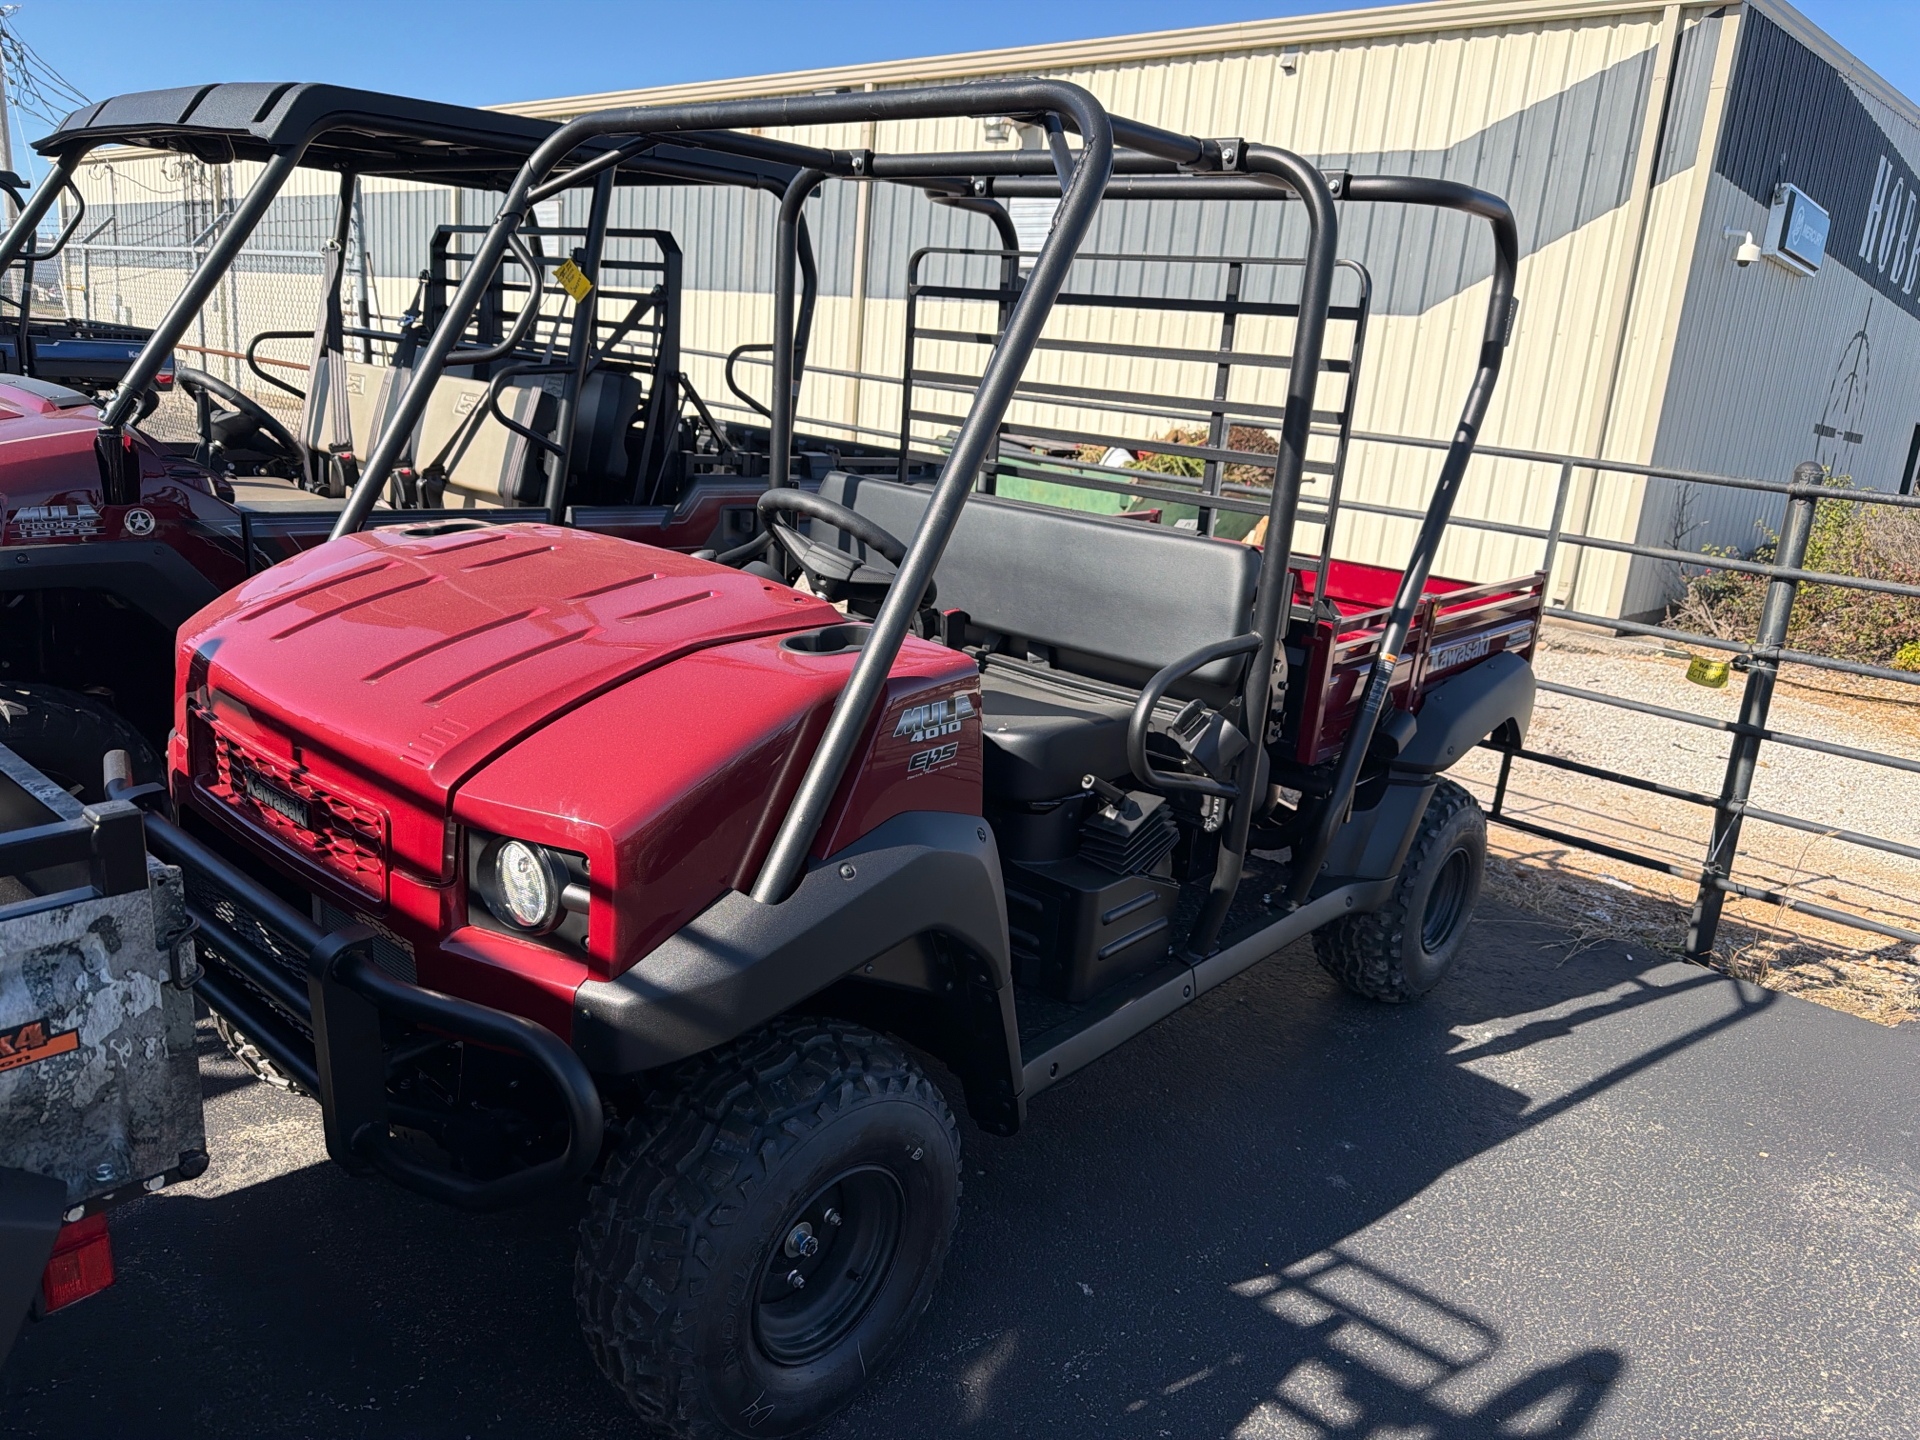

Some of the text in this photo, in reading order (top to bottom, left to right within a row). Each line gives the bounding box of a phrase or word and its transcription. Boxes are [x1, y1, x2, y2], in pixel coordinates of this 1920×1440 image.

[1858, 154, 1920, 304] HOBB
[10, 505, 103, 524] MULE
[1430, 632, 1490, 671] Kawasaki
[893, 695, 976, 737] MULE
[910, 721, 961, 742] 4010
[907, 741, 959, 772] EPS
[246, 770, 309, 829] Kawasaki
